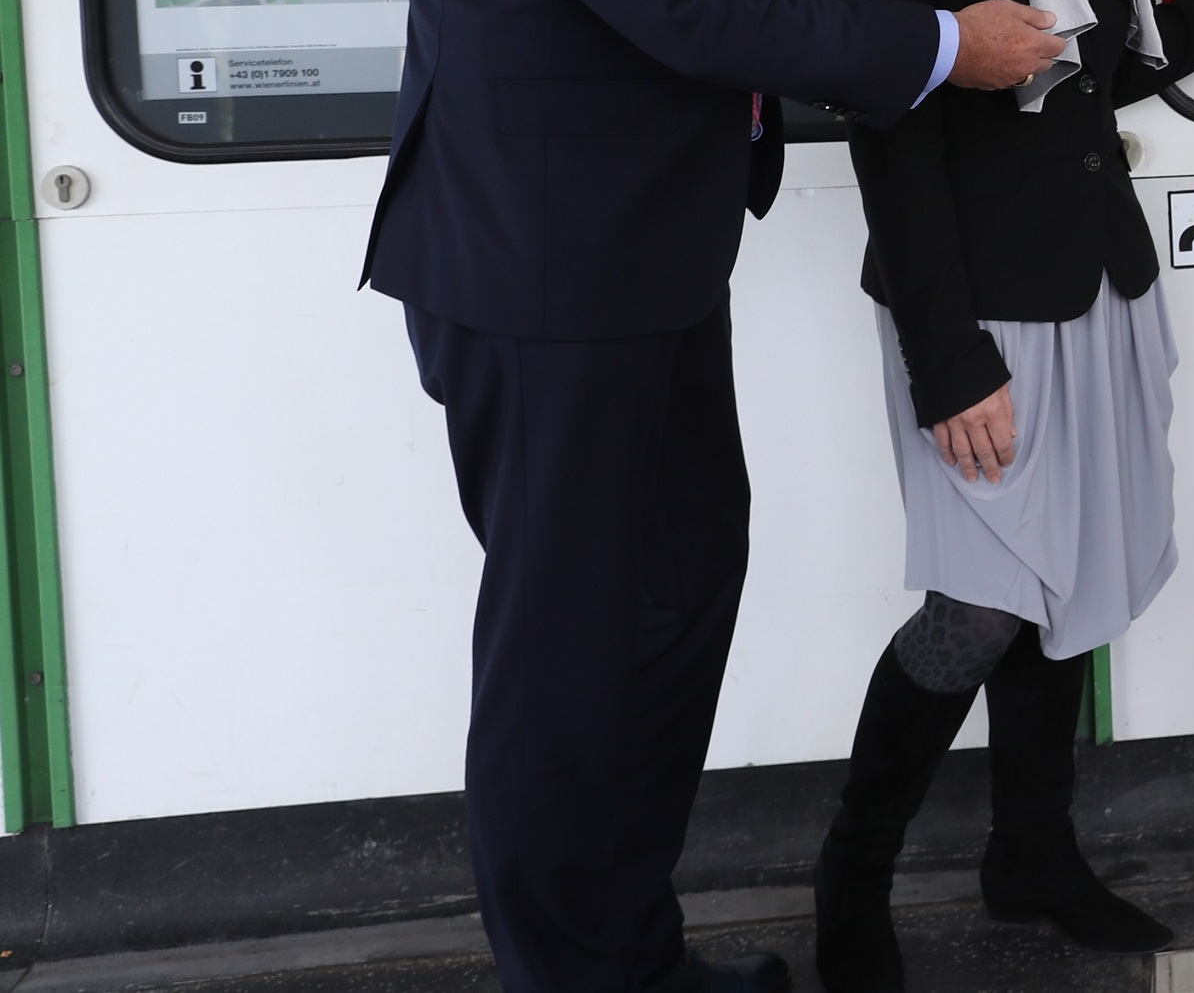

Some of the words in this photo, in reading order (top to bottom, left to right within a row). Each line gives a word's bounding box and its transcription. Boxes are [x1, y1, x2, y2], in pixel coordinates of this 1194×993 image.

[228, 58, 293, 68] Servicetelefon
[230, 71, 248, 79] +43
[251, 70, 269, 80] (0)1
[273, 69, 298, 78] 7909
[302, 68, 319, 77] 100
[229, 80, 321, 90] www.wienerlinien.at
[181, 114, 204, 122] FB09
